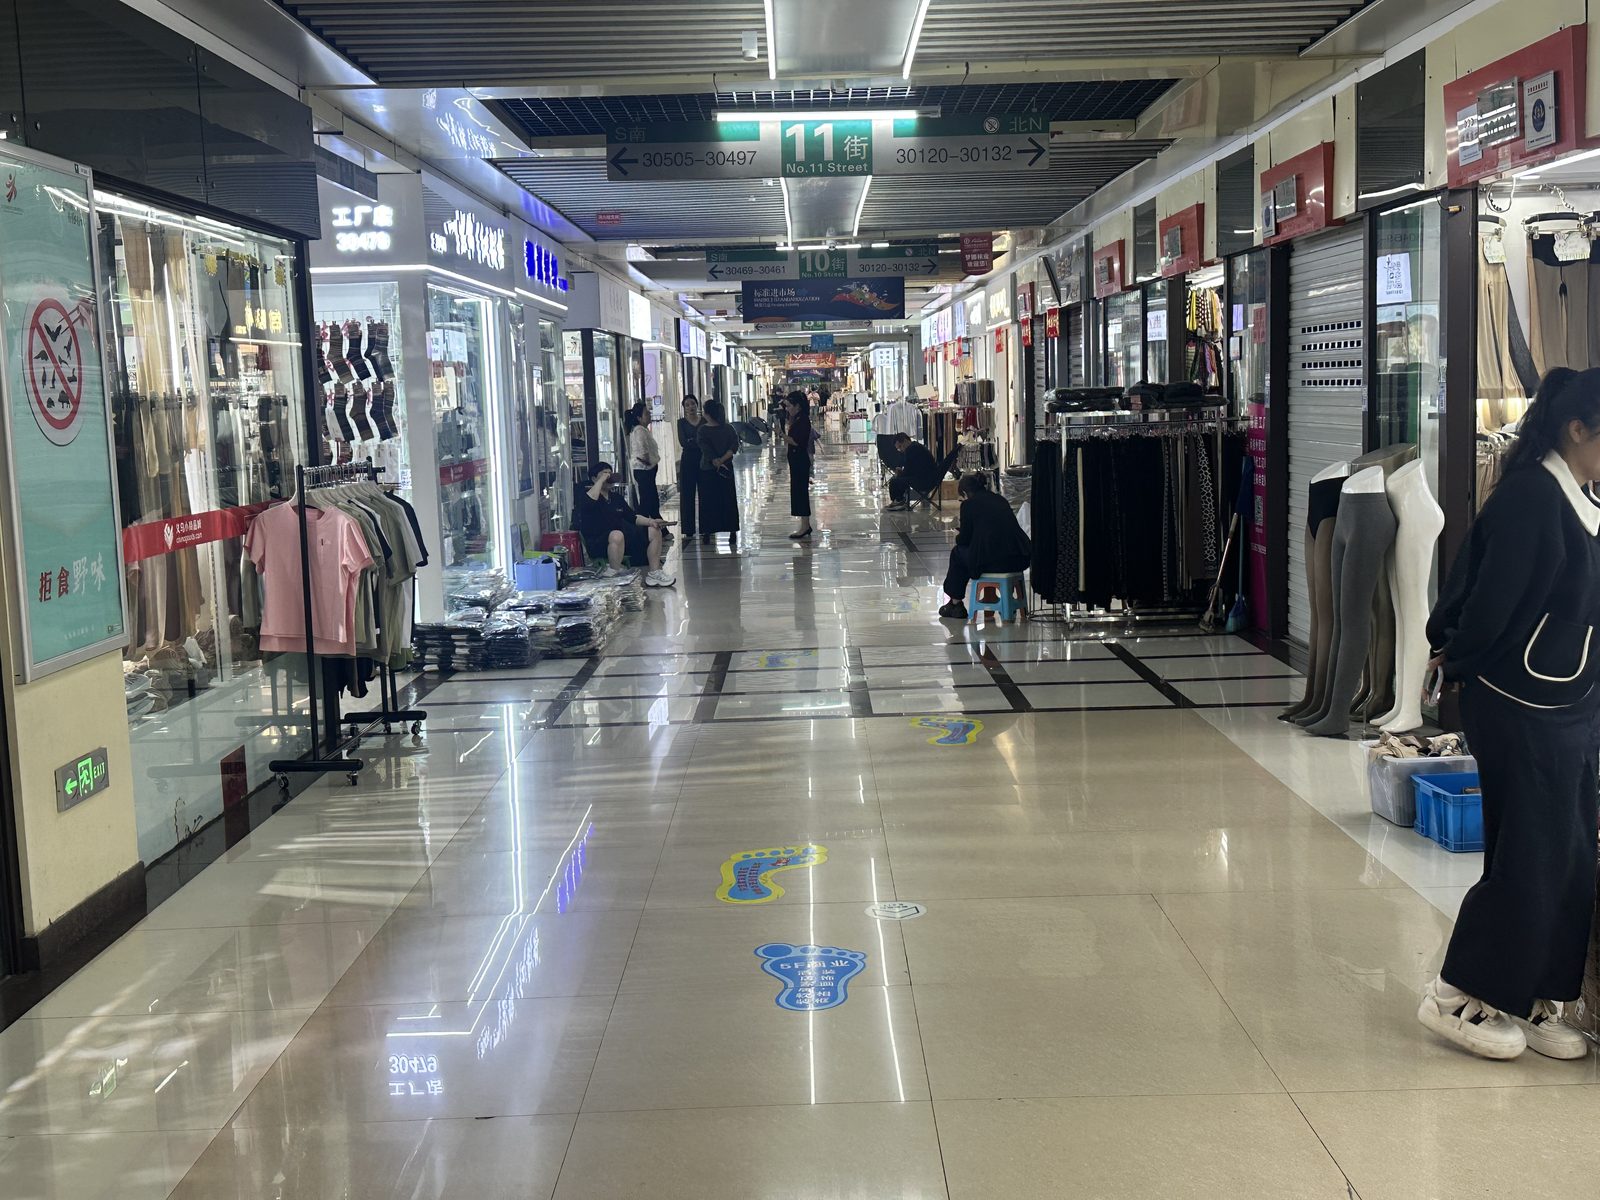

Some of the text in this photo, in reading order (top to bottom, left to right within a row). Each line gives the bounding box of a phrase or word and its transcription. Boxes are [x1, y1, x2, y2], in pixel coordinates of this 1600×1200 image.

[642, 151, 757, 167] 30505-30497
[896, 146, 1012, 163] 30120-30132
[786, 162, 868, 174] No.11 Street
[859, 263, 920, 273] 30120-30132
[39, 551, 106, 602] 拒食野味
